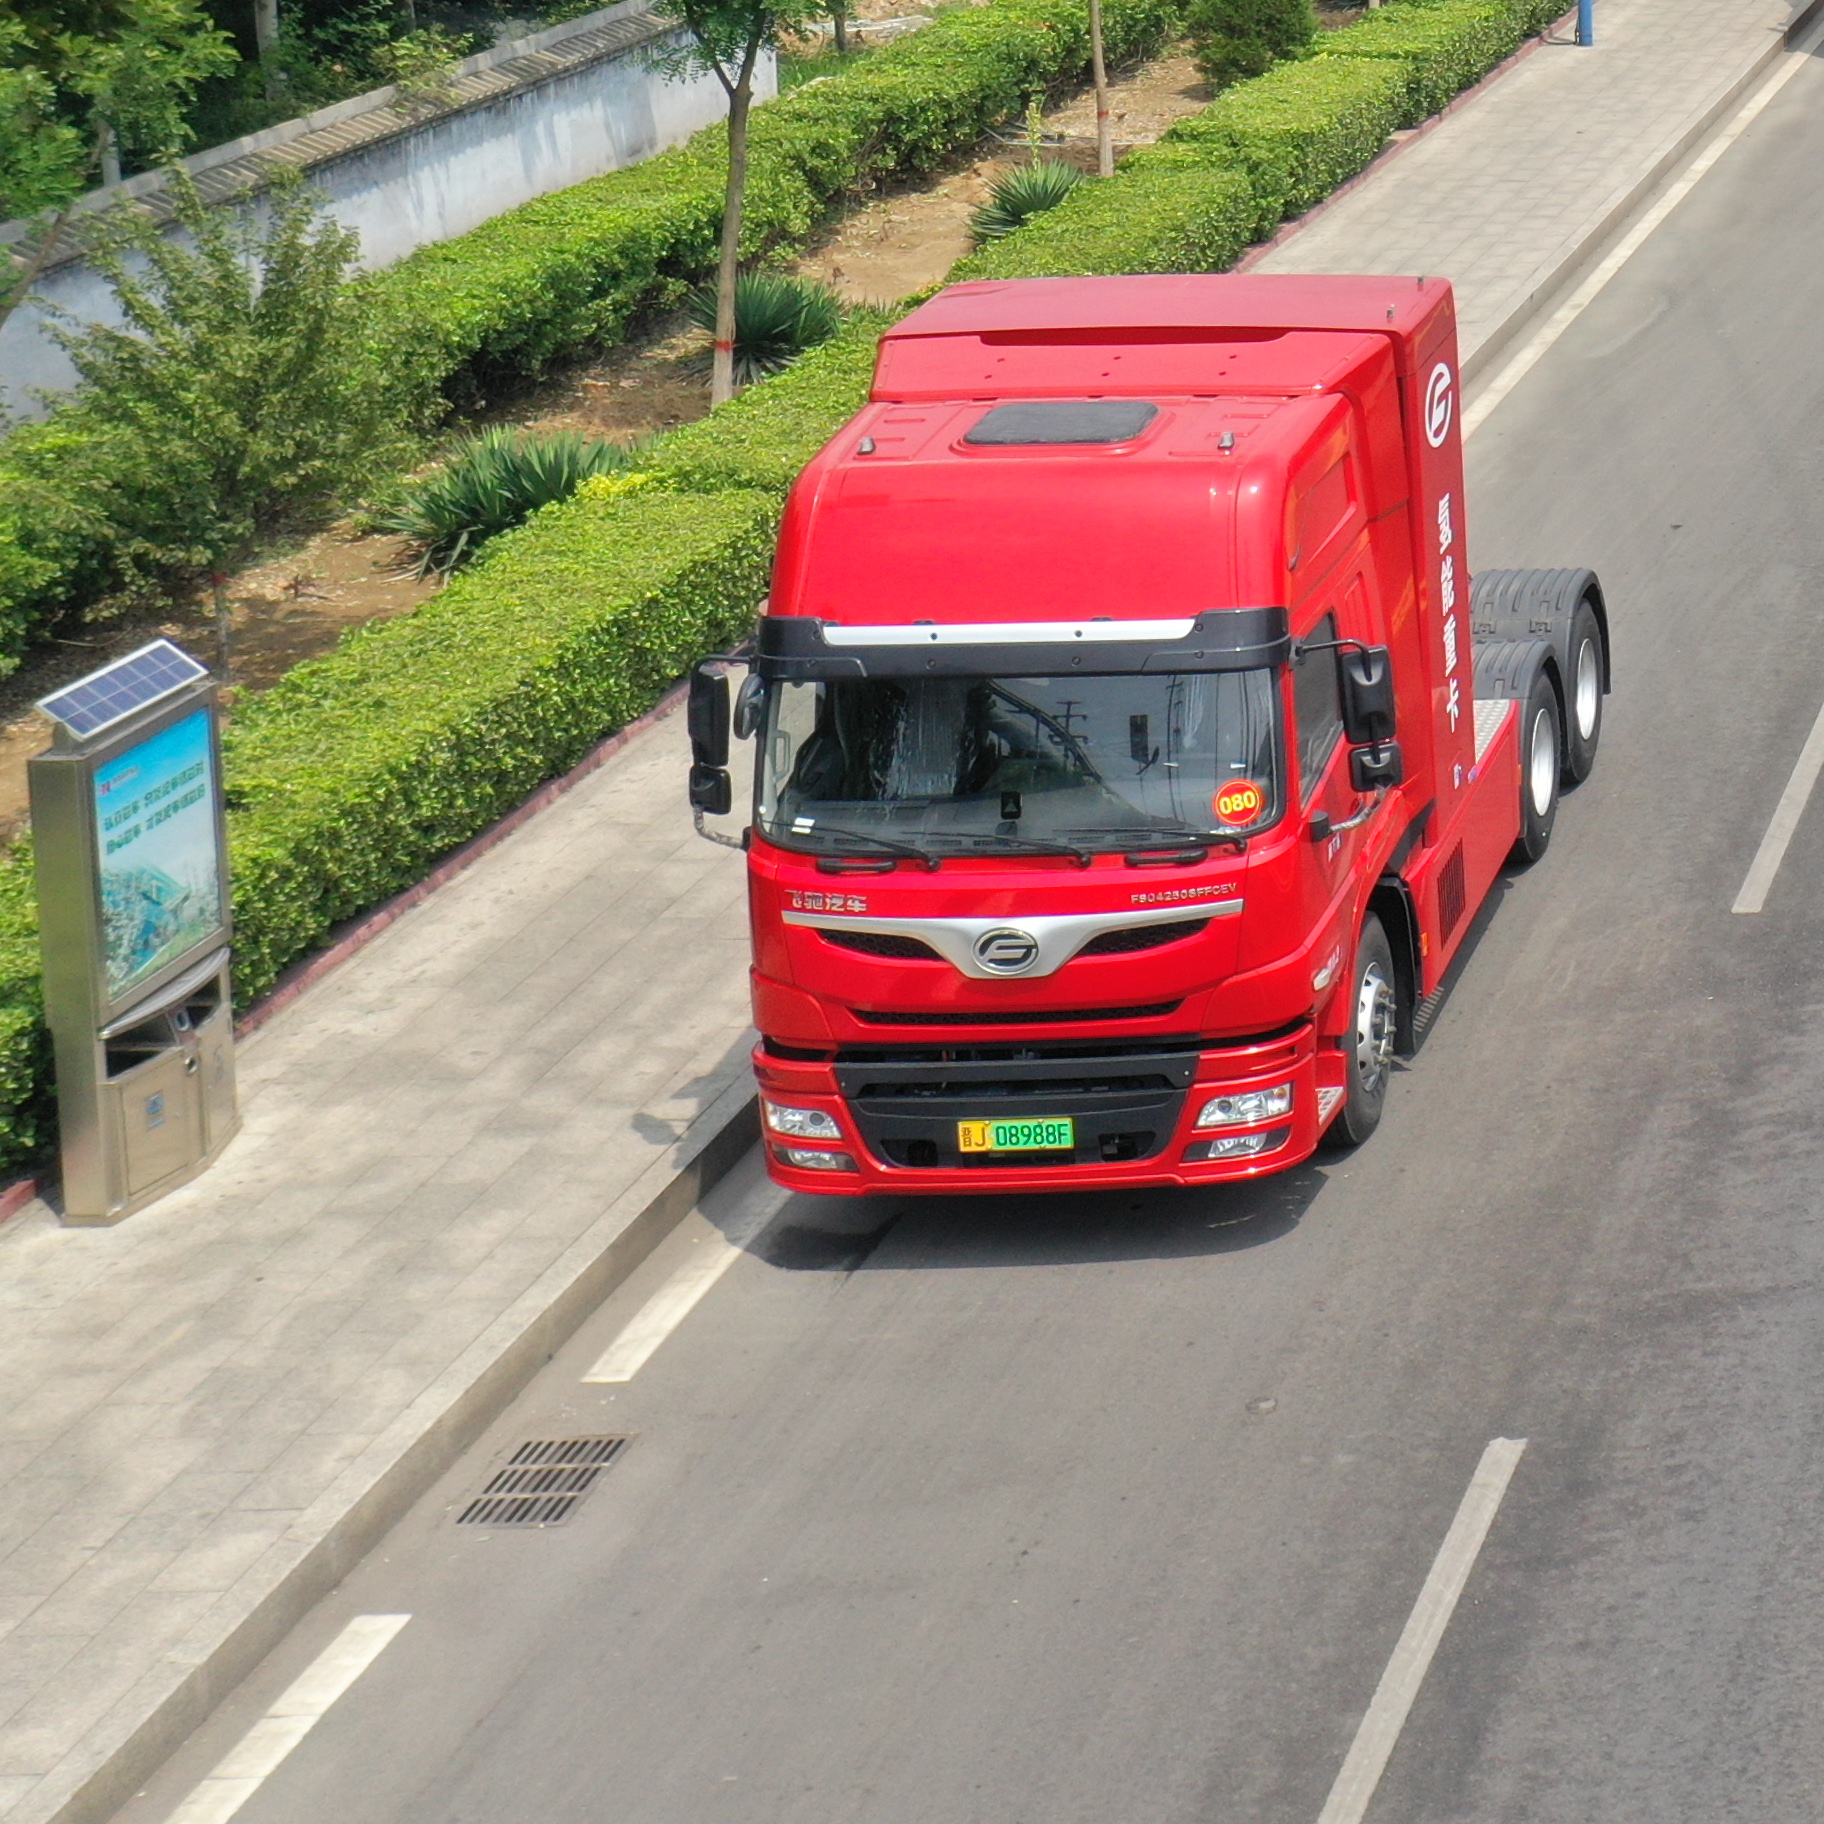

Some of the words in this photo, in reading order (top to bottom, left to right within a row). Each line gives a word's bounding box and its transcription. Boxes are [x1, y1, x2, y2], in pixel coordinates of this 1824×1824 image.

[1219, 791, 1256, 815] 080
[784, 889, 868, 913] 飞驰汽车
